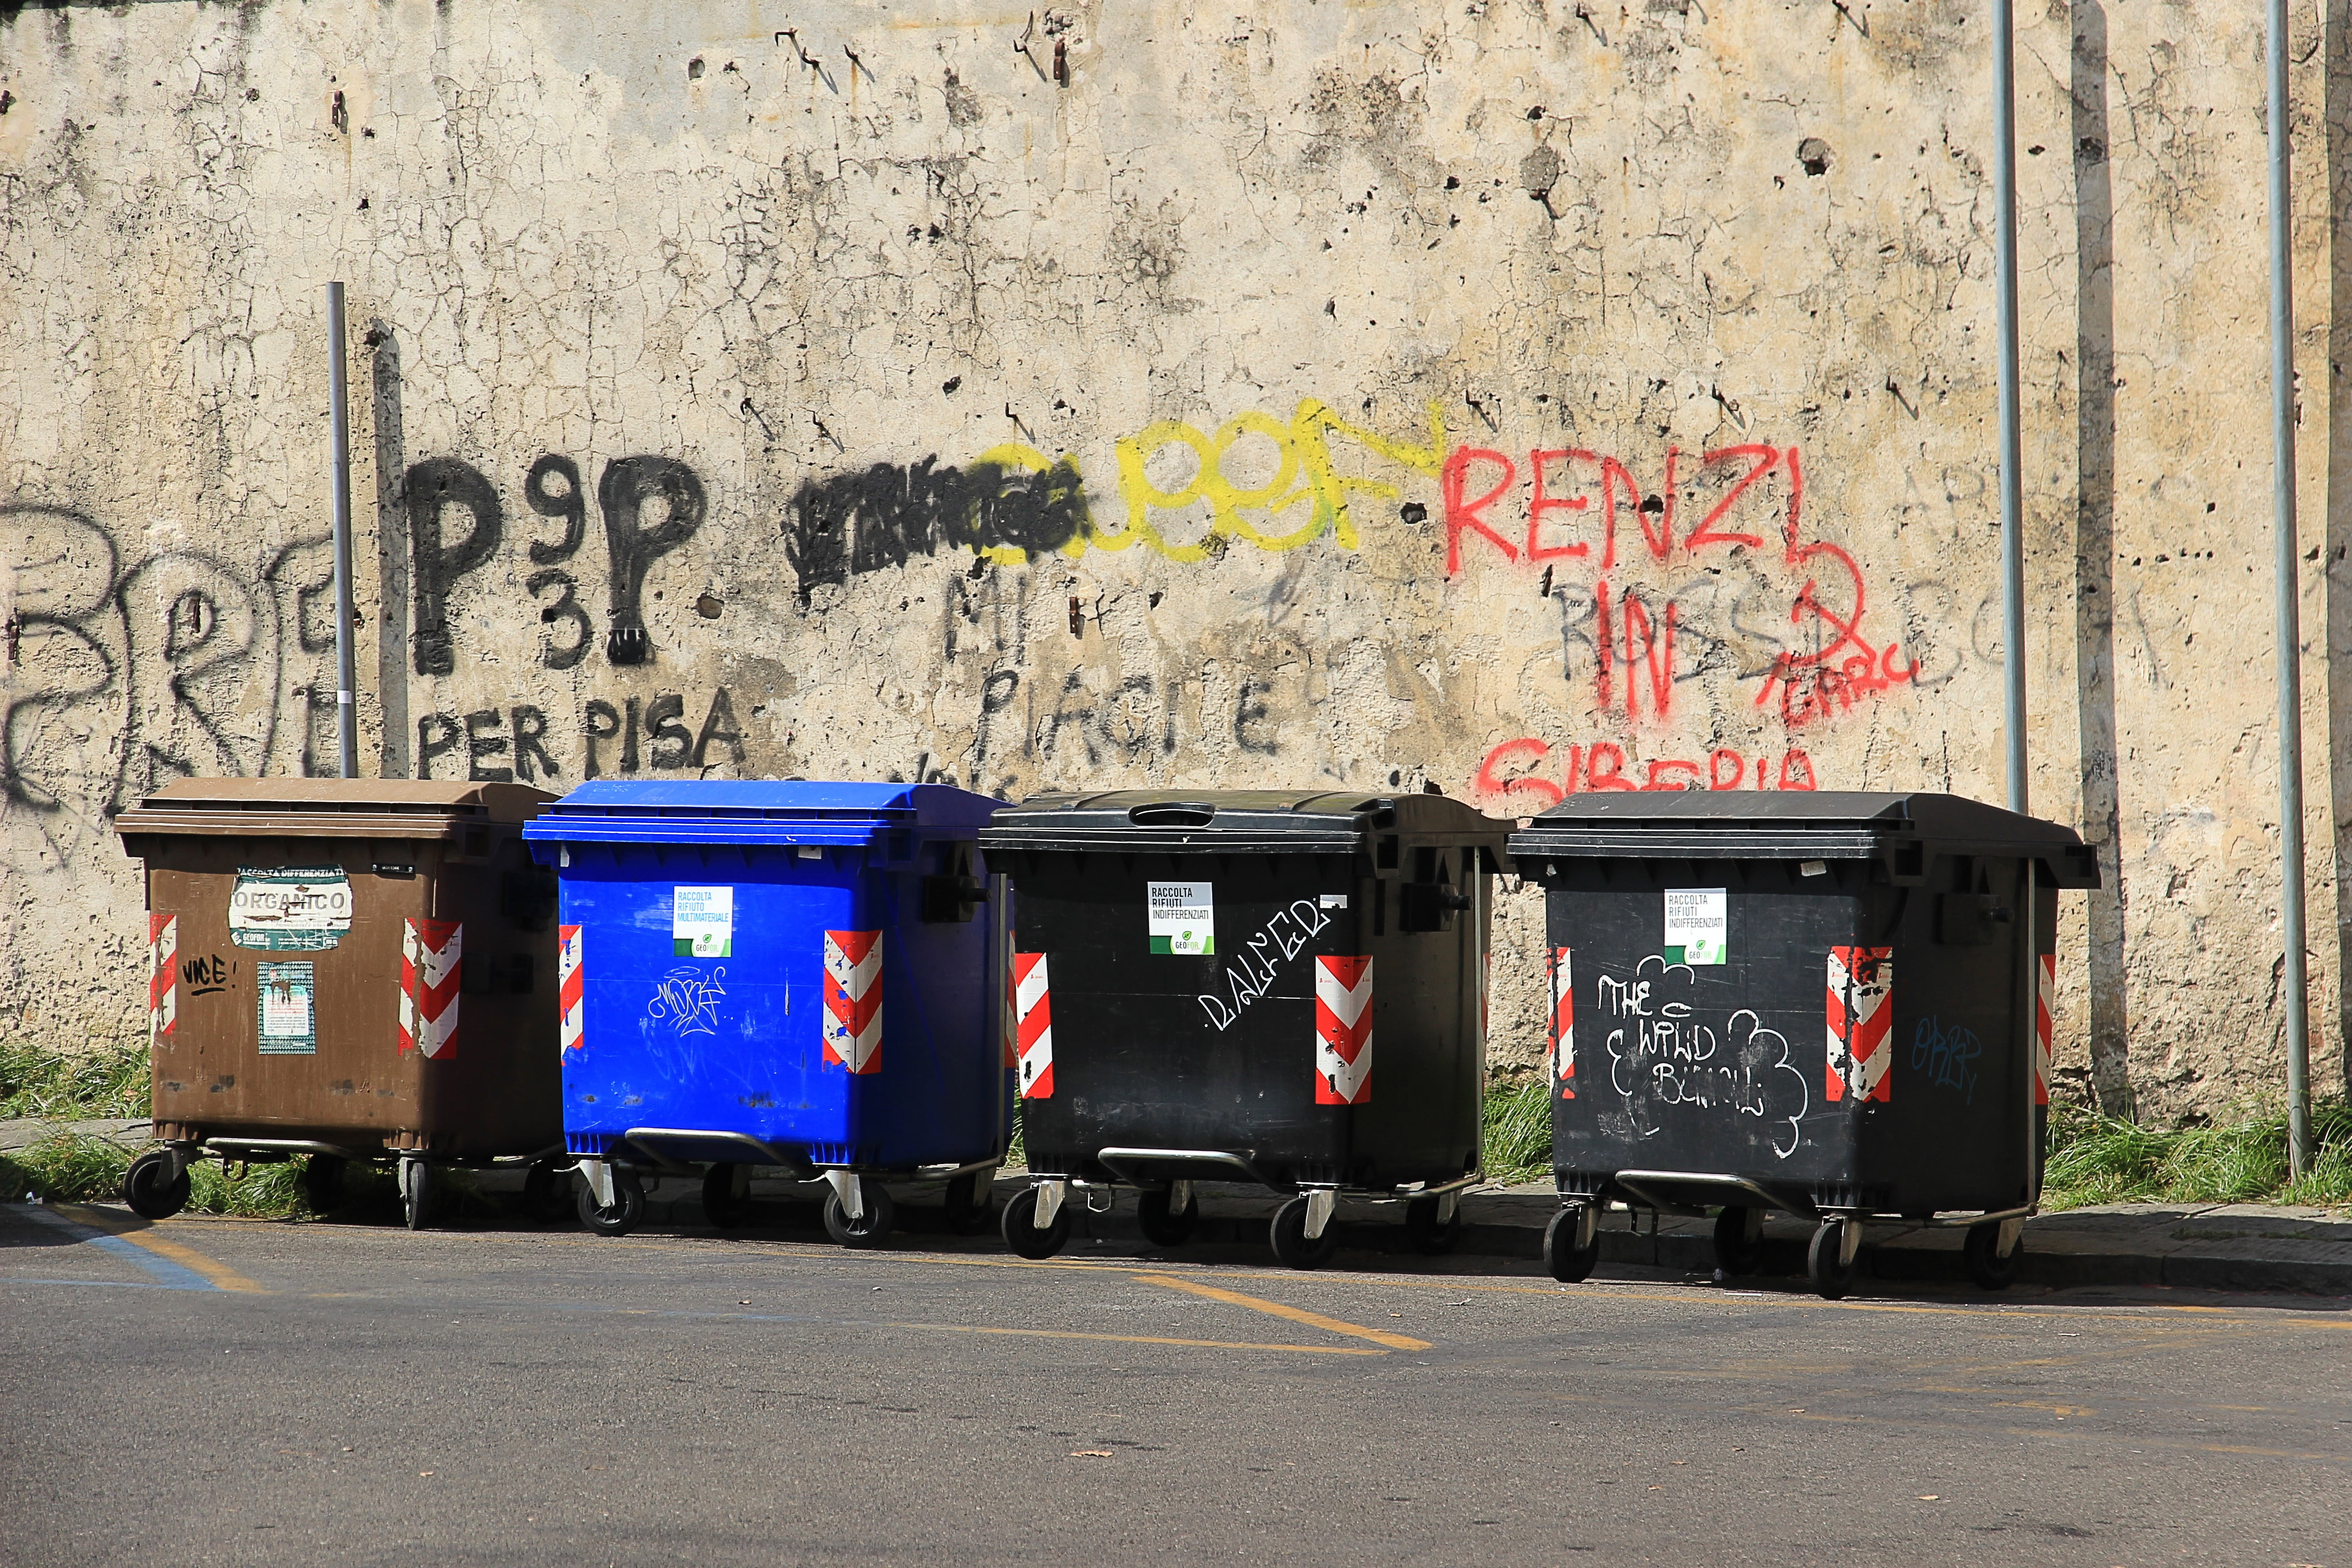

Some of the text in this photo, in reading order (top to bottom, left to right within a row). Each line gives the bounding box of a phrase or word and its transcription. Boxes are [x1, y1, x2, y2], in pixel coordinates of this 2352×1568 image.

[1442, 444, 1804, 575] RENZI
[417, 687, 746, 783] PER PISA
[678, 892, 711, 901] RACCOLTA
[1152, 887, 1192, 897] RACCOLTA
[234, 892, 344, 910] ORGANICO
[1152, 898, 1181, 908] RIFIUTI
[1669, 895, 1708, 905] RACCOLTA
[678, 902, 704, 911] RIFIUTO
[1669, 906, 1697, 916] RIFIUTI
[677, 912, 729, 922] MULTIMATERIALE
[1153, 910, 1209, 919] INDIFFERENZIATI
[1670, 918, 1723, 928] INDIFFERENZIATI
[1598, 975, 1653, 1019] THE
